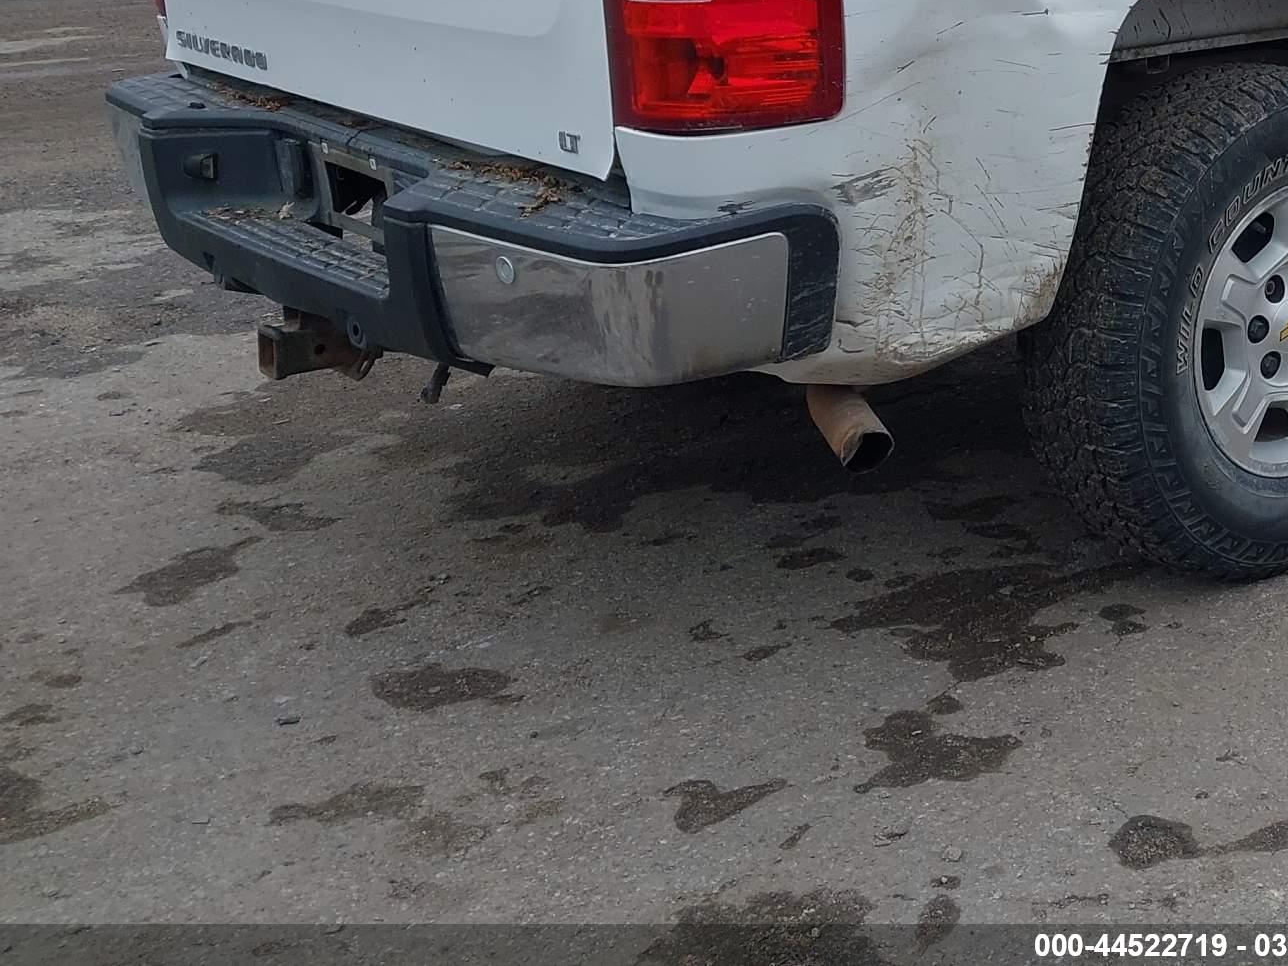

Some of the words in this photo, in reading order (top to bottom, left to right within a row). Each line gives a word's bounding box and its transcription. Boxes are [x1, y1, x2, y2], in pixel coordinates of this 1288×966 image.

[176, 30, 268, 71] SILVERADO
[558, 131, 581, 154] LT
[1176, 265, 1205, 376] WILD
